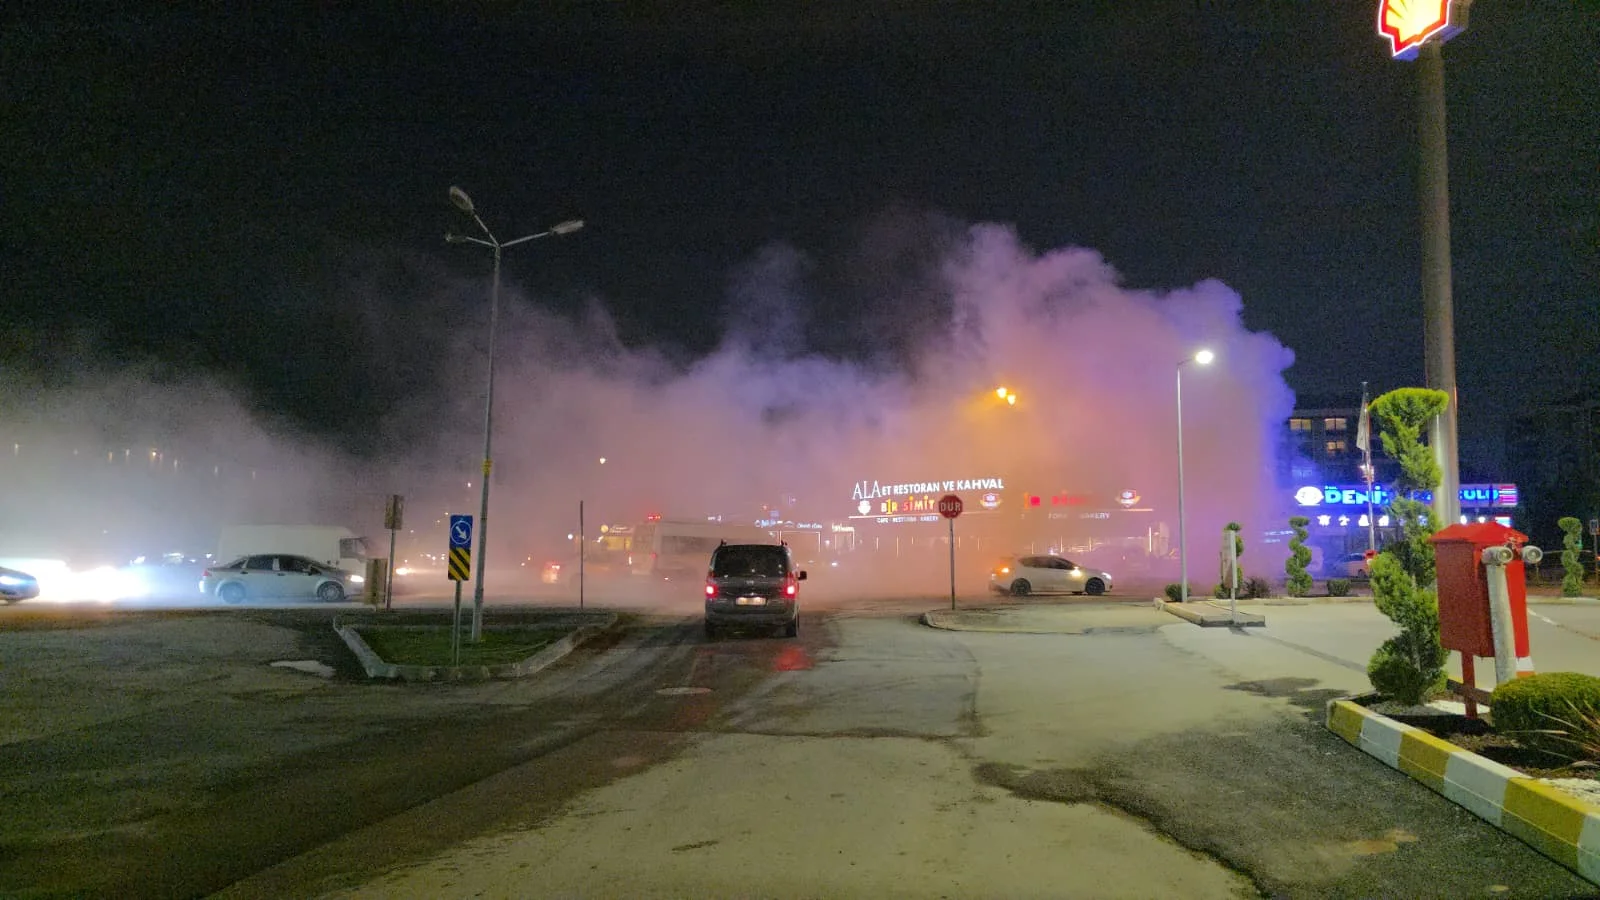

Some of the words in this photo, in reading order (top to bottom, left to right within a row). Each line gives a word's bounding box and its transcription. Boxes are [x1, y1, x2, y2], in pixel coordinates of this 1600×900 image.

[852, 480, 882, 500] ALA
[882, 486, 891, 496] ET
[893, 482, 940, 495] RESTORAN
[942, 480, 955, 491] VE
[957, 478, 1004, 490] KAHVAL
[940, 501, 961, 512] DUR
